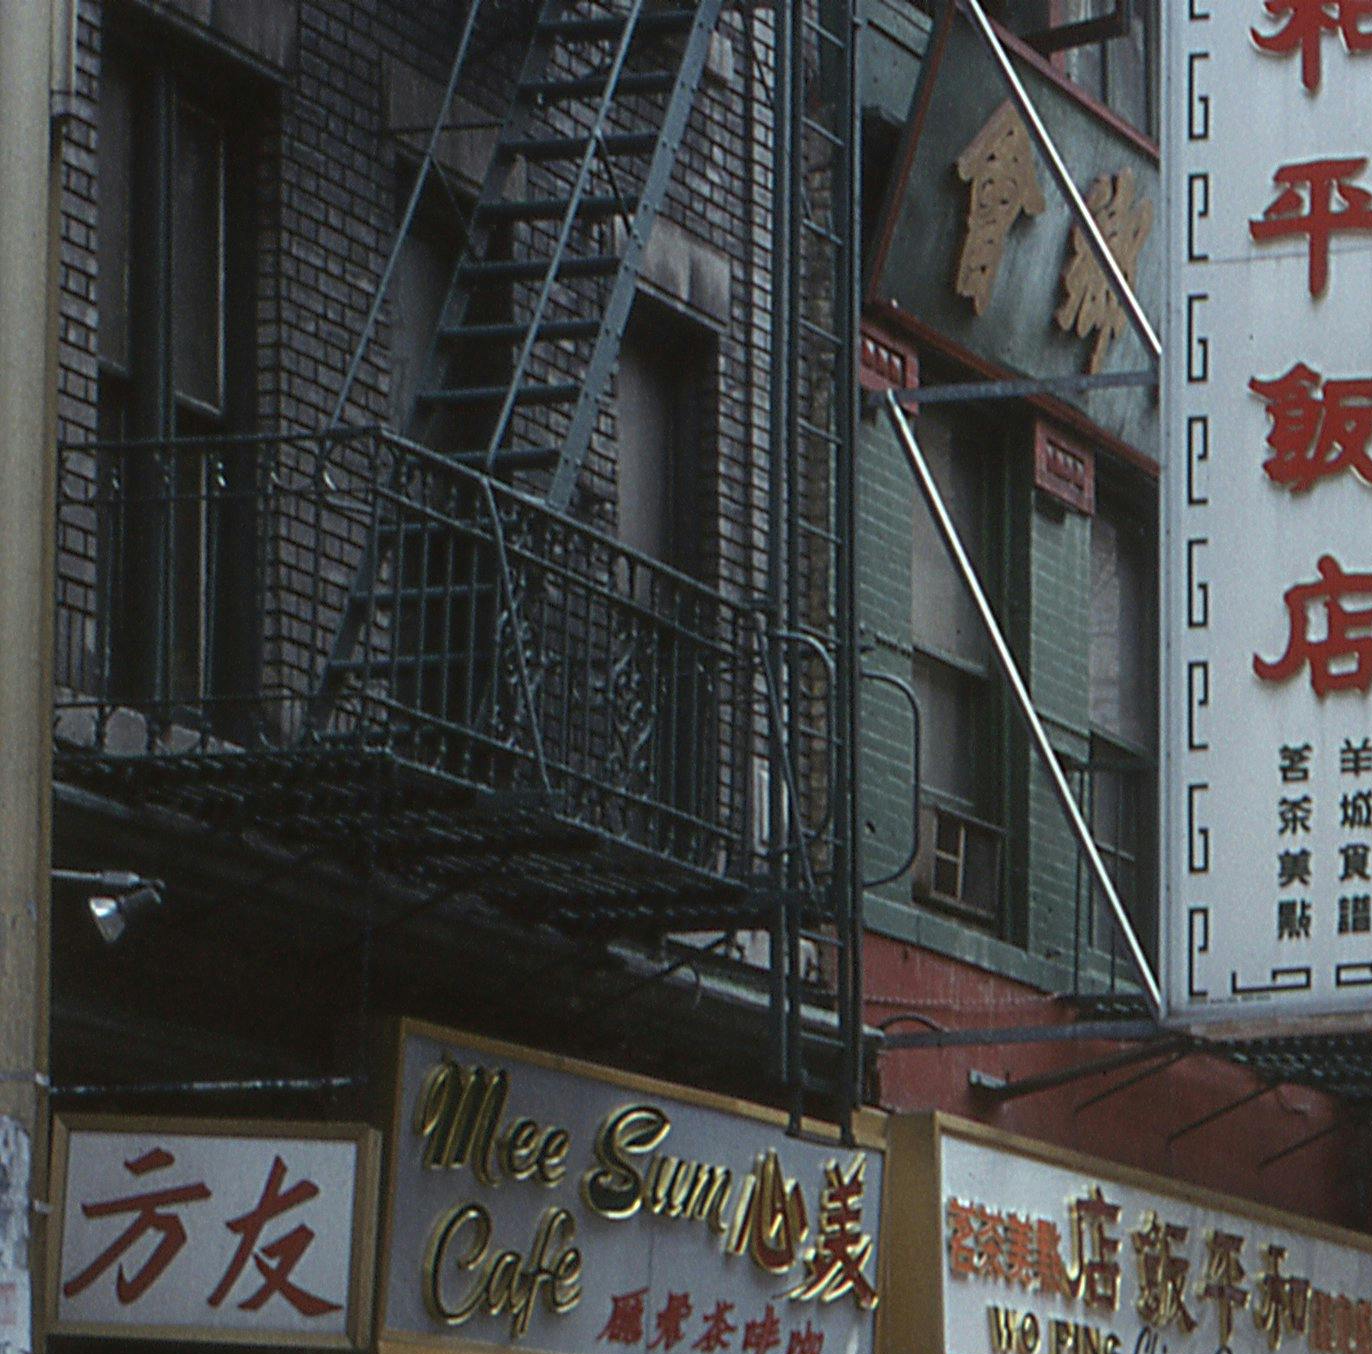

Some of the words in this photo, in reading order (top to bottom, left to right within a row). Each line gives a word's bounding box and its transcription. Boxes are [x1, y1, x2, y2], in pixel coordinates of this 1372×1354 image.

[415, 1052, 571, 1188] Mee
[581, 1103, 731, 1235] Sum
[422, 1202, 584, 1338] Cafe
